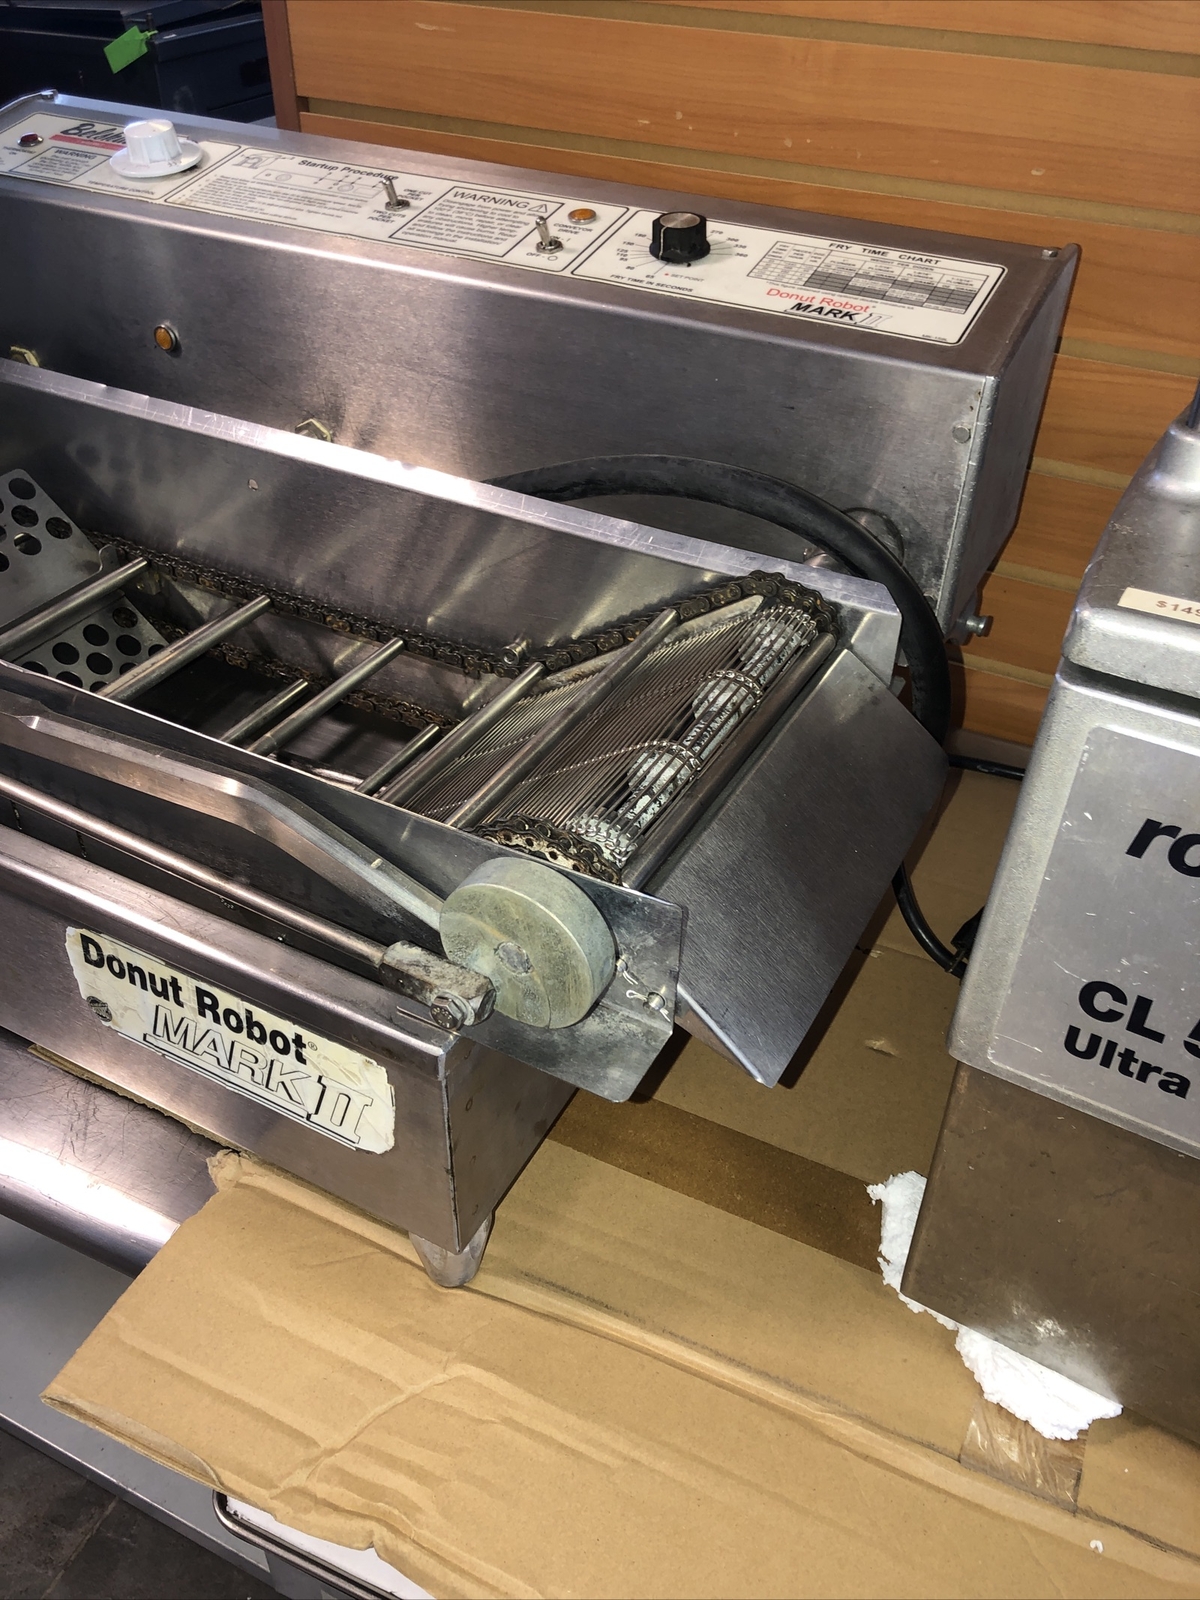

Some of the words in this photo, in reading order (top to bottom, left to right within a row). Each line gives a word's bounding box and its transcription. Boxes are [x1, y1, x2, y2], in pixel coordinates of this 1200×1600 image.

[54, 149, 97, 159] WARNING
[298, 160, 339, 171] Startup
[340, 166, 399, 180] Procedure
[453, 190, 530, 209] WARNING
[553, 222, 594, 233] CONVEYOR
[829, 242, 852, 251] FRY
[861, 248, 890, 257] TIME
[898, 254, 942, 265] CHART
[655, 281, 694, 293] SECONDS
[766, 288, 816, 303] Donut
[790, 302, 861, 321] MARK
[79, 933, 184, 1008] Donut
[1078, 981, 1166, 1044] CL
[1063, 1025, 1191, 1100] Ultra
[152, 1005, 313, 1107] MARK
[306, 1074, 374, 1144] II
